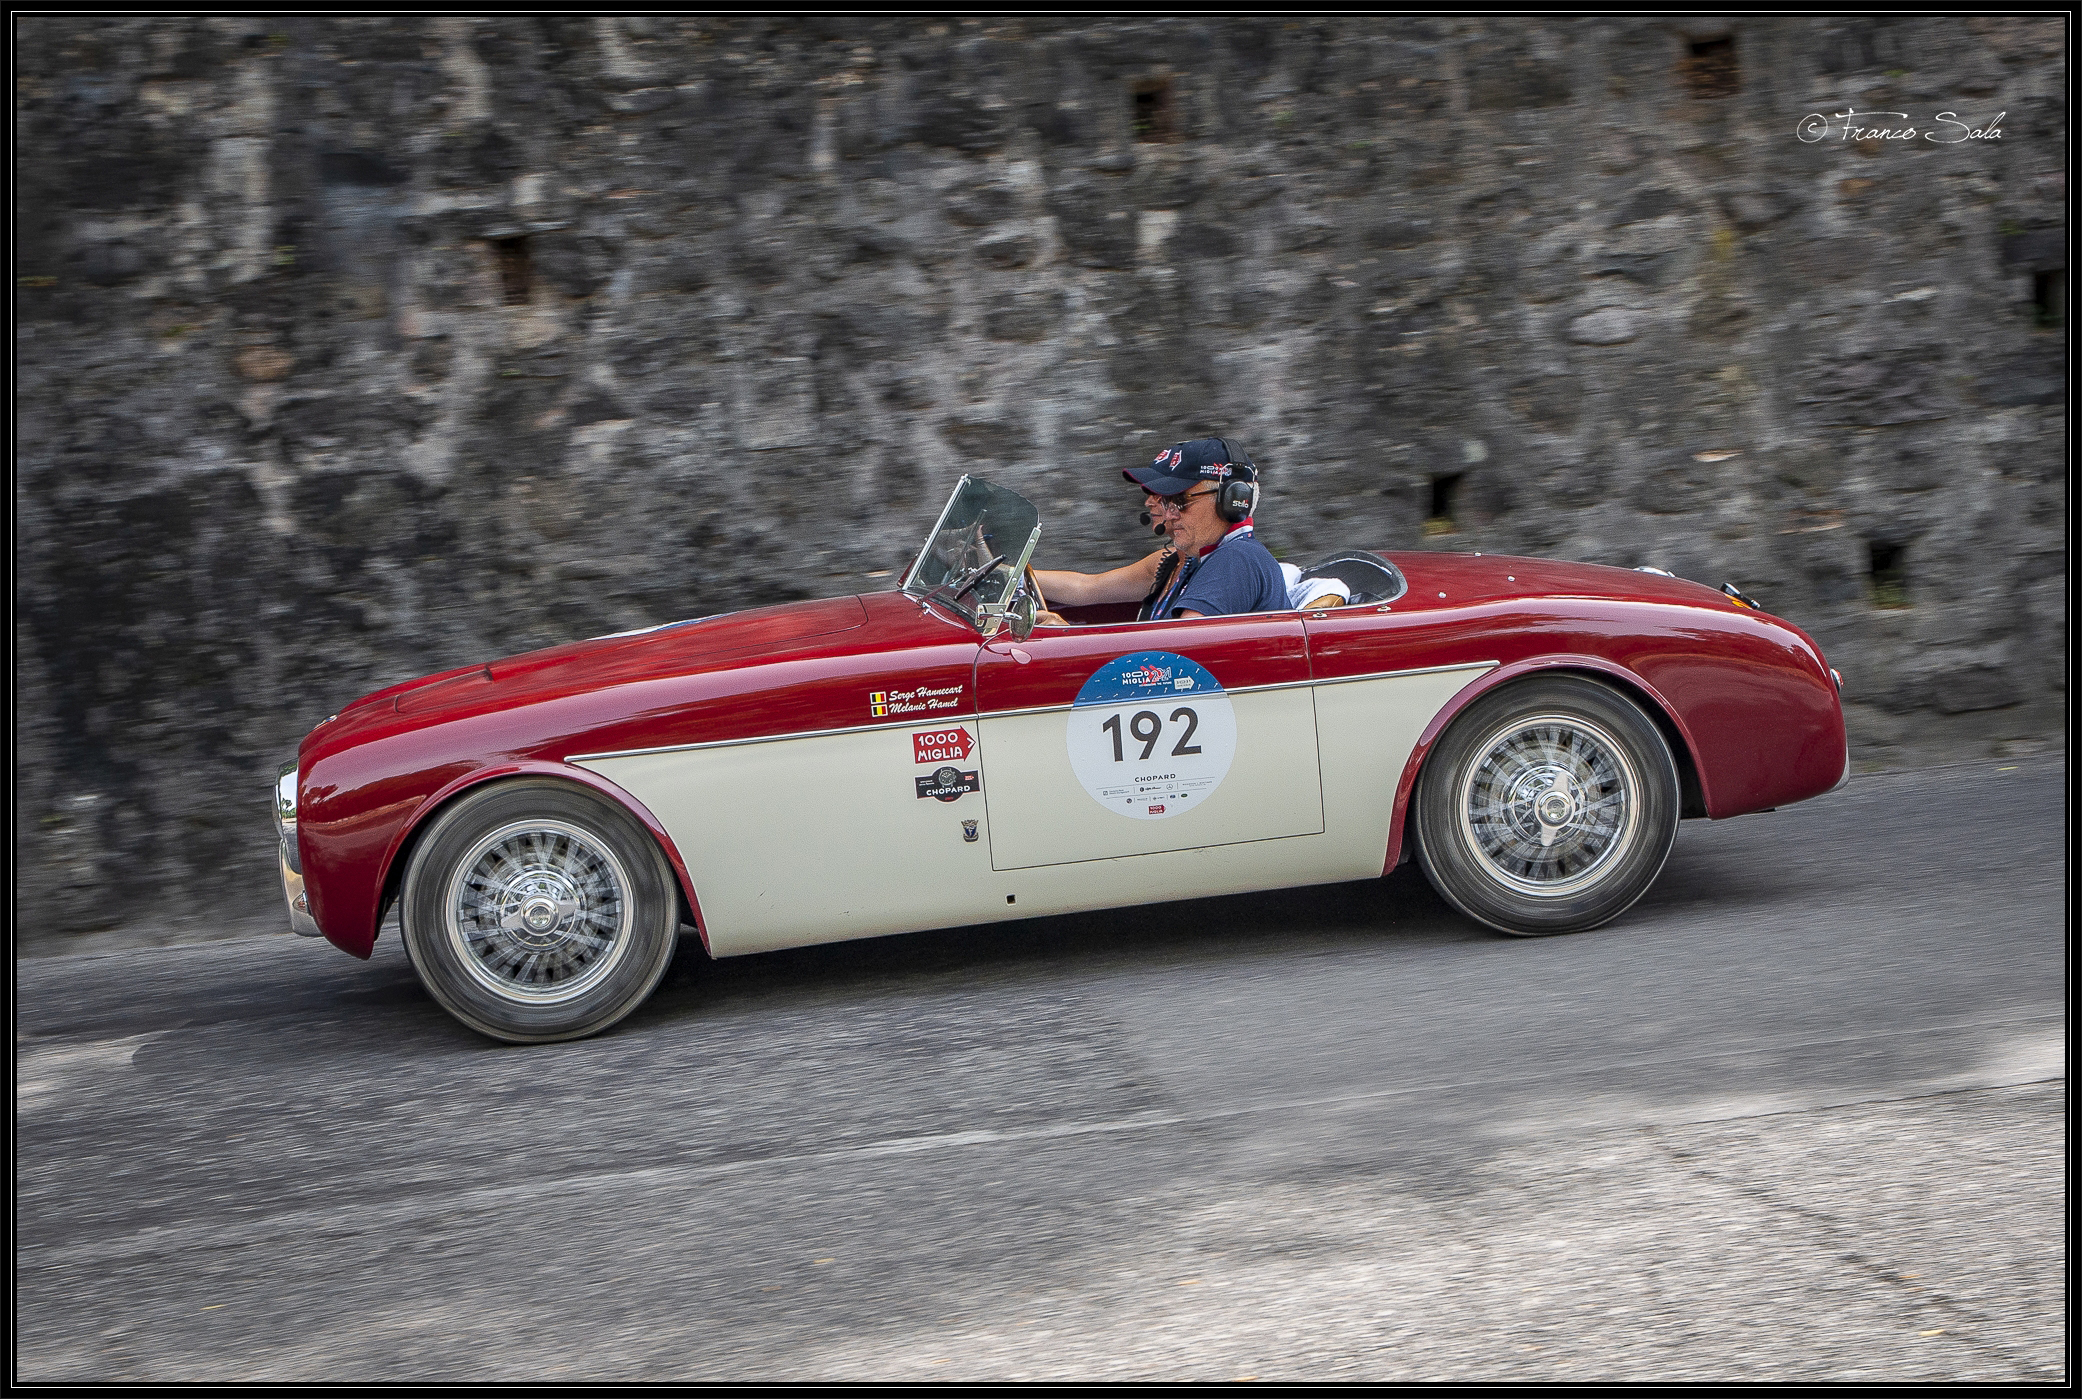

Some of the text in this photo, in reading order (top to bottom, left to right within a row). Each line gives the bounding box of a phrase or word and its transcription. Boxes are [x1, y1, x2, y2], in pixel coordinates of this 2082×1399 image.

[1122, 677, 1151, 686] MIGLIA
[888, 684, 963, 702] Serge Hannecart
[888, 697, 959, 713] Melanie Hamel
[918, 732, 959, 747] 1000
[1102, 706, 1202, 762] 192
[917, 746, 963, 762] MIGLIA
[1134, 773, 1176, 783] CHOPARD
[926, 785, 971, 796] CHOPARD
